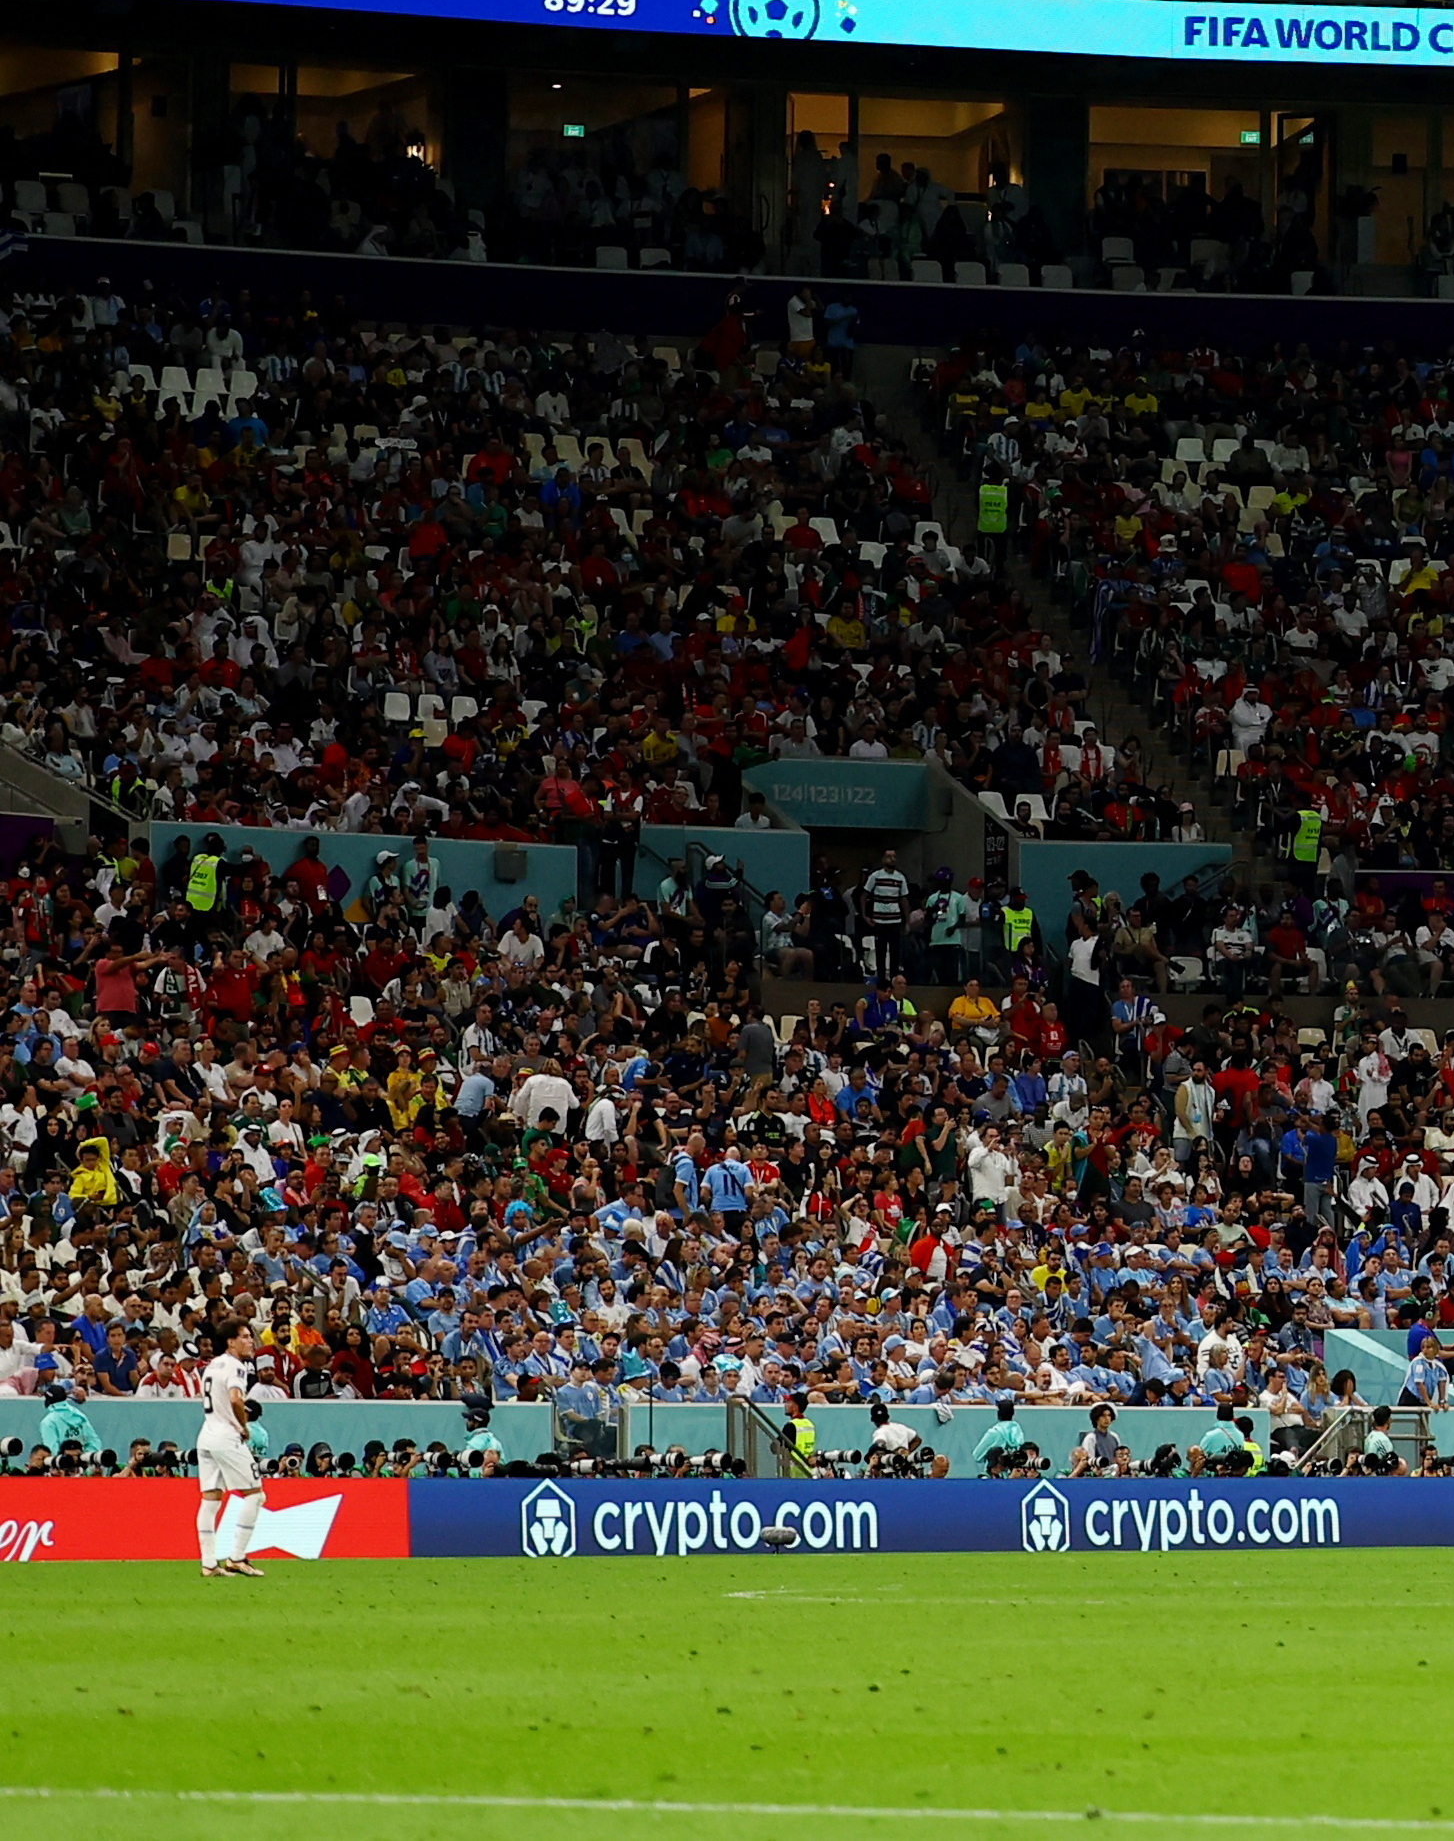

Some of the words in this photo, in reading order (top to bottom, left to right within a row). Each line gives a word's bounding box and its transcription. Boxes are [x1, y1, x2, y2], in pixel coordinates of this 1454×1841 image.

[1184, 16, 1270, 49] FIFA
[1275, 18, 1421, 53] WORLD
[1085, 1488, 1340, 1552] crypto.com
